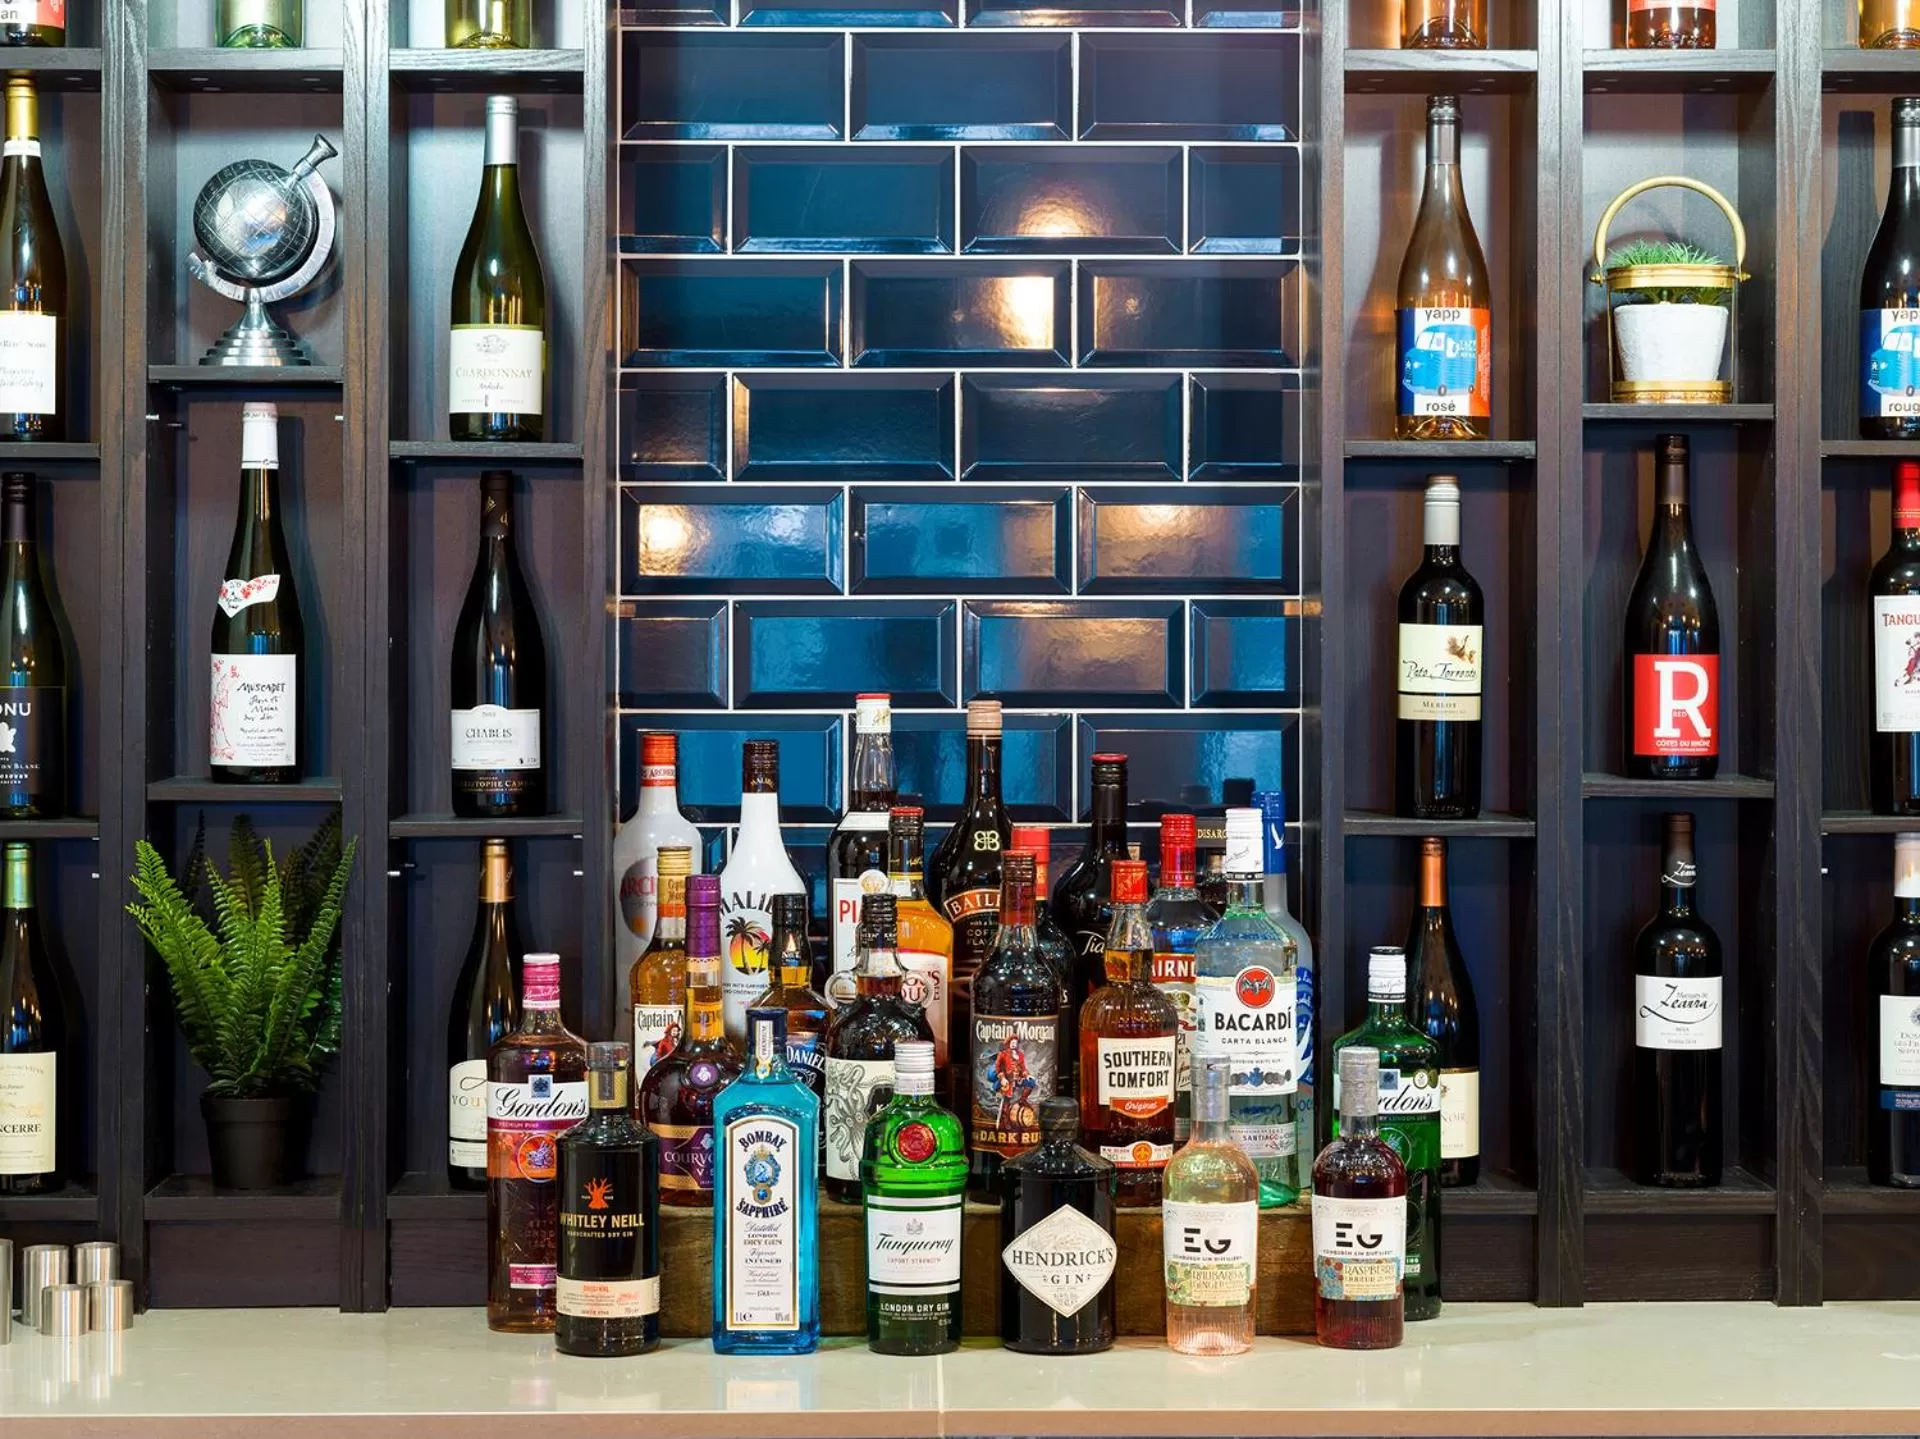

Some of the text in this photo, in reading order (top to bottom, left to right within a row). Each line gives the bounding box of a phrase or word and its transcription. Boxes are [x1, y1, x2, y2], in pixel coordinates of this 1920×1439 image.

[1425, 309, 1460, 321] yapp
[455, 366, 532, 378] CHARDONNAY
[1426, 400, 1456, 412] rosé
[236, 682, 287, 694] MUSCADET
[1422, 701, 1457, 709] MERLOT
[1653, 661, 1712, 738] R
[0, 702, 31, 717] NU
[465, 728, 513, 738] CHABLIS
[637, 1009, 673, 1031] Captain
[1215, 1006, 1291, 1031] BACARDÍ
[976, 1020, 1055, 1043] Captain Morgan
[1255, 1036, 1287, 1044] BLANCA
[1103, 1050, 1173, 1069] SOUTHERN
[1109, 1070, 1169, 1088] COMFORT
[495, 1087, 587, 1118] Gordon's
[1124, 1101, 1158, 1112] Original
[738, 1130, 787, 1152] BOMBAY
[981, 1130, 1017, 1144] DARK
[736, 1197, 788, 1218] SAPPHIRE
[560, 1212, 645, 1228] WHITLEY NEILL
[876, 1233, 955, 1255] Tanqueray
[1012, 1247, 1113, 1267] HENDRICK'S
[1050, 1273, 1085, 1285] GIN
[881, 1302, 950, 1312] LONDON DRY GIN
